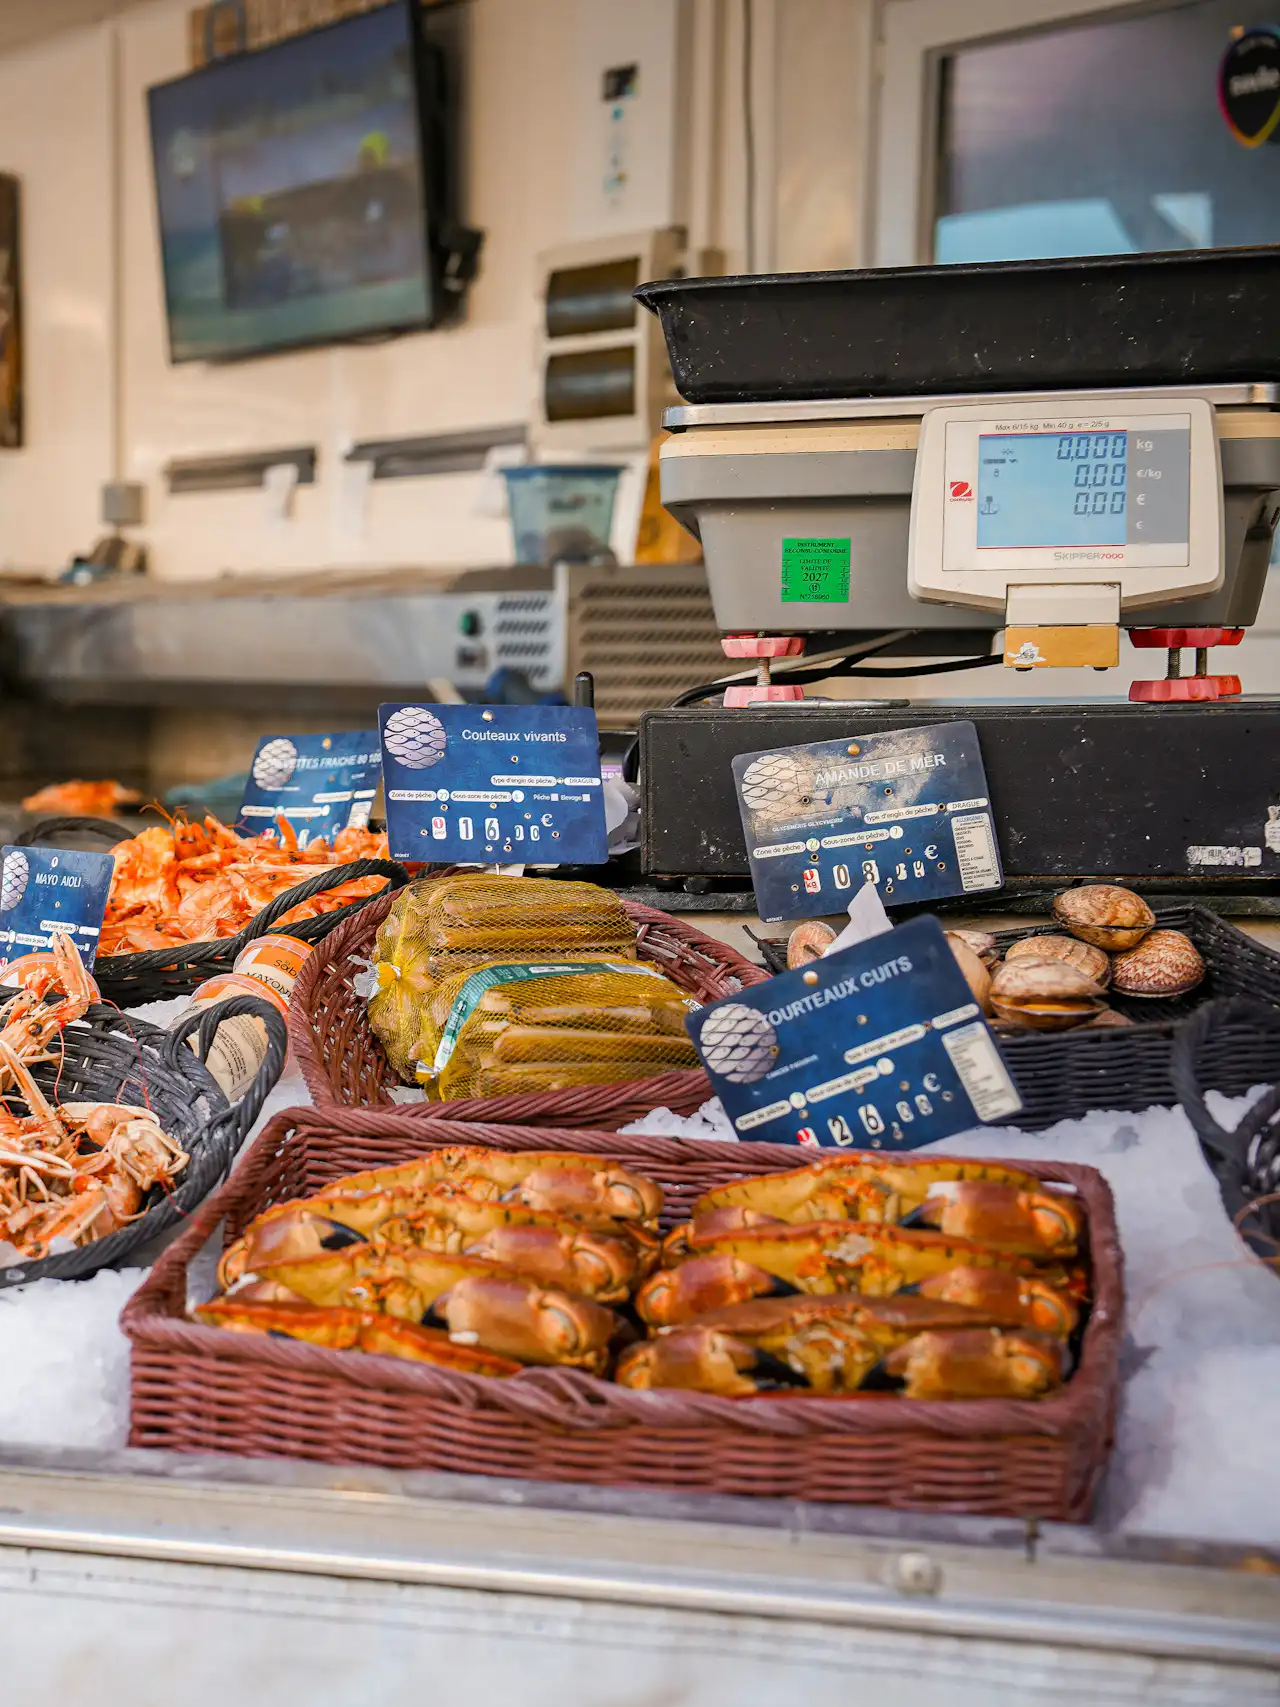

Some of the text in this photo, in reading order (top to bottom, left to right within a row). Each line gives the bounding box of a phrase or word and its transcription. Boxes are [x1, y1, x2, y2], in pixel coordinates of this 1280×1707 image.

[1057, 436, 1127, 462] 0,000
[1136, 439, 1153, 451] kg
[1074, 464, 1127, 489] 0,00
[1136, 469, 1162, 480] €/kg
[1074, 491, 1127, 516] 0,00
[1136, 494, 1146, 506] €
[802, 573, 829, 582] 2027
[462, 730, 567, 742] Couteaux vivants
[815, 754, 947, 786] AMANDE DE MER
[492, 778, 504, 786] Type
[535, 778, 553, 786] pêche
[414, 792, 433, 800] pêche
[490, 793, 508, 801] pêche
[866, 814, 881, 824] Type
[882, 811, 906, 822] d'engin
[915, 806, 934, 816] pêche
[952, 800, 980, 809] DRAGUE
[541, 814, 554, 827] €
[756, 848, 771, 856] Zone
[782, 844, 800, 854] pêche
[824, 836, 854, 846] Sous-zone
[856, 834, 864, 842] de
[866, 832, 885, 842] pêche
[924, 844, 939, 860] €
[36, 873, 82, 888] MAYO AIOLI
[806, 882, 818, 890] kg
[274, 960, 298, 978] sab
[760, 956, 914, 1027] TOURTEAUX CUITS
[924, 1074, 941, 1092] €
